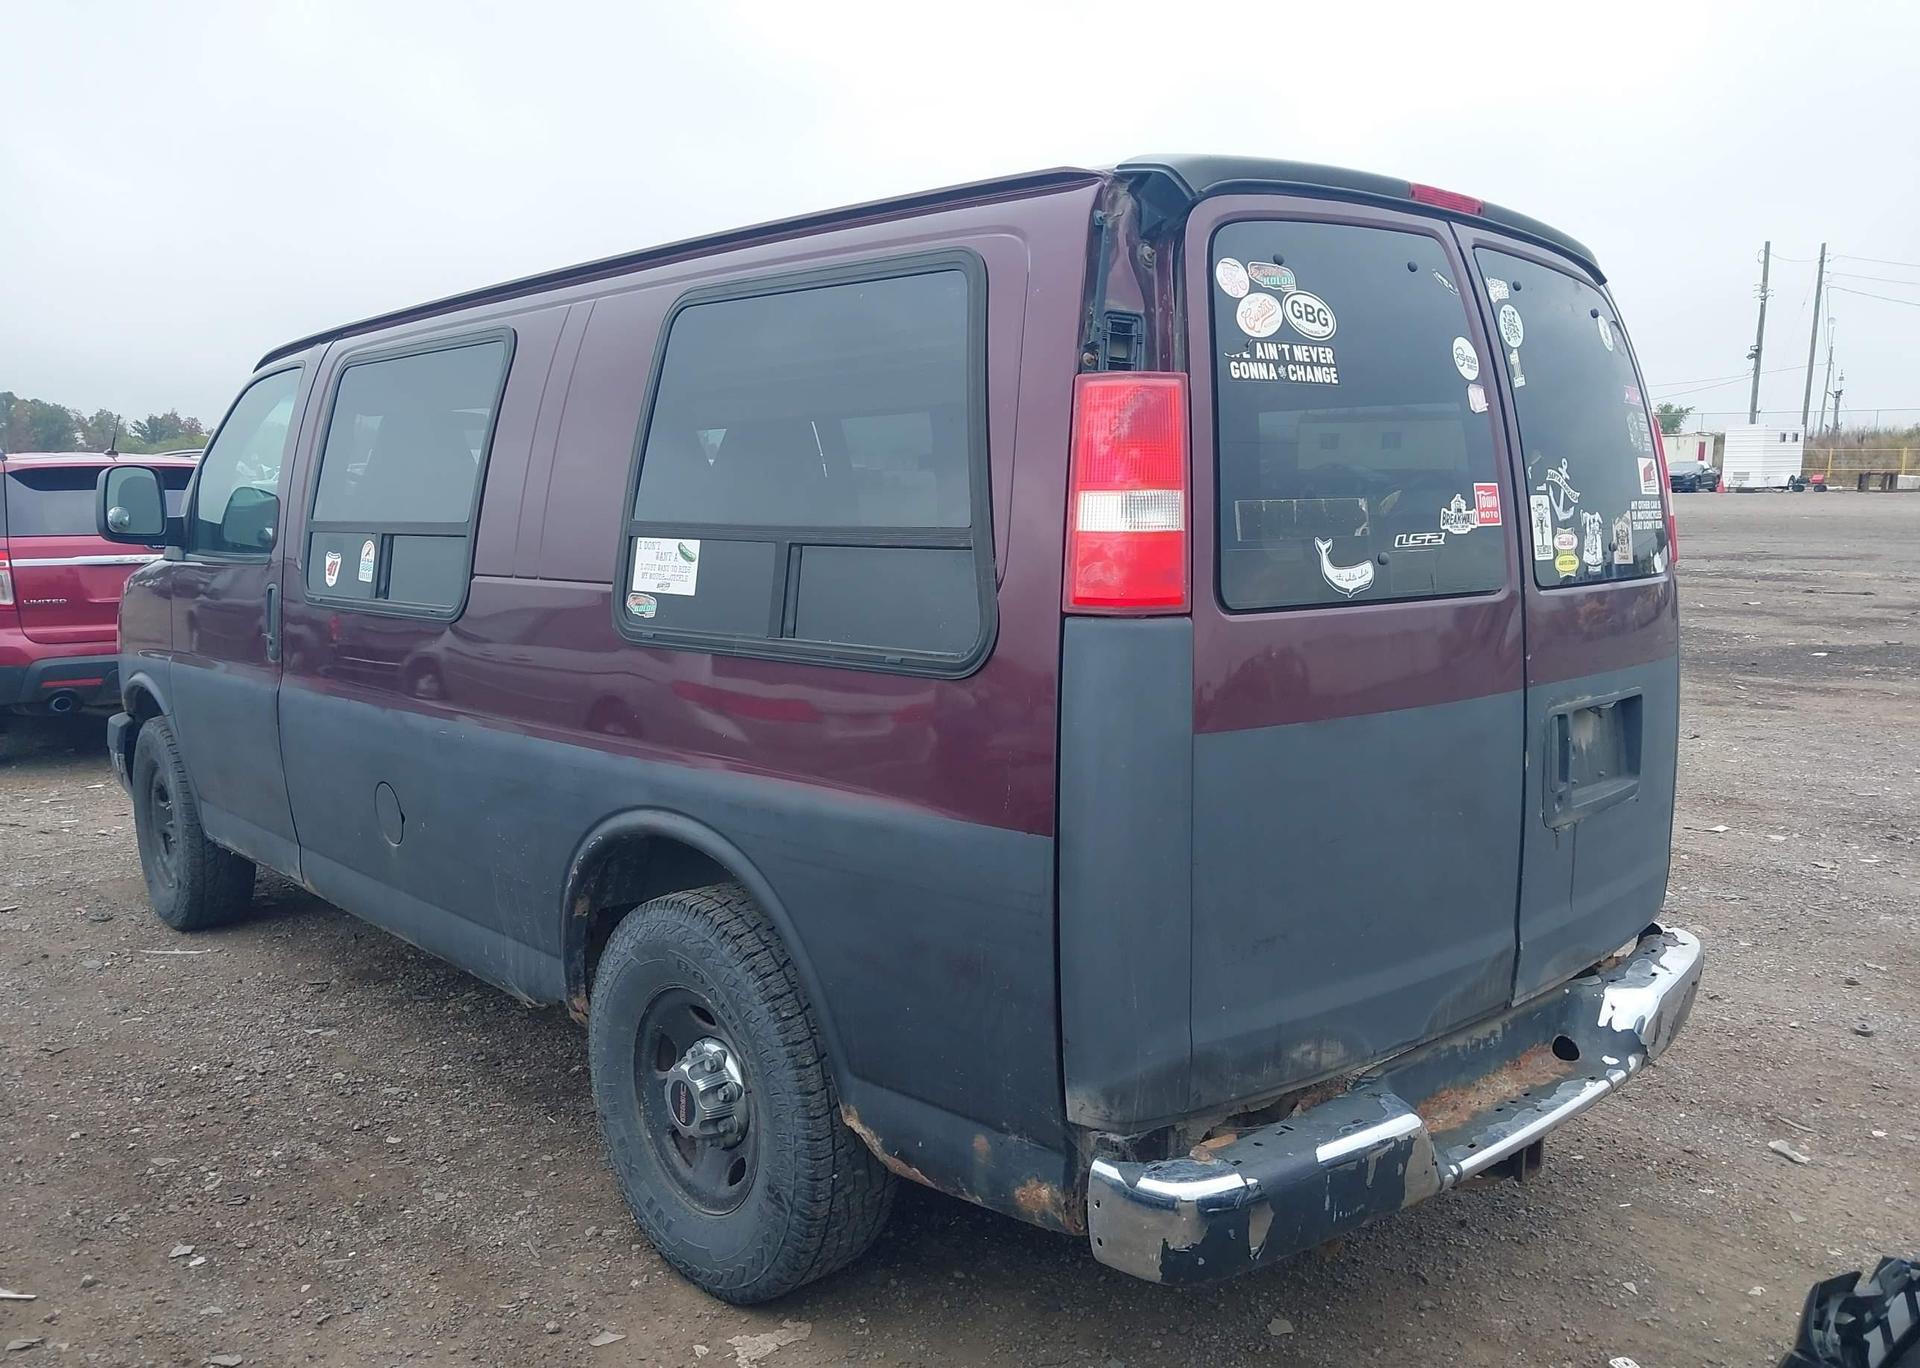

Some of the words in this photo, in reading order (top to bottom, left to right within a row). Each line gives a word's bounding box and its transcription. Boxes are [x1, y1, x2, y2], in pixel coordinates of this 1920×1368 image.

[1290, 299, 1330, 329] GBG
[1255, 342, 1290, 361] AIN'T
[1293, 344, 1336, 364] NEVER
[1229, 361, 1278, 381] GONNA
[1287, 364, 1339, 385] CHANGE
